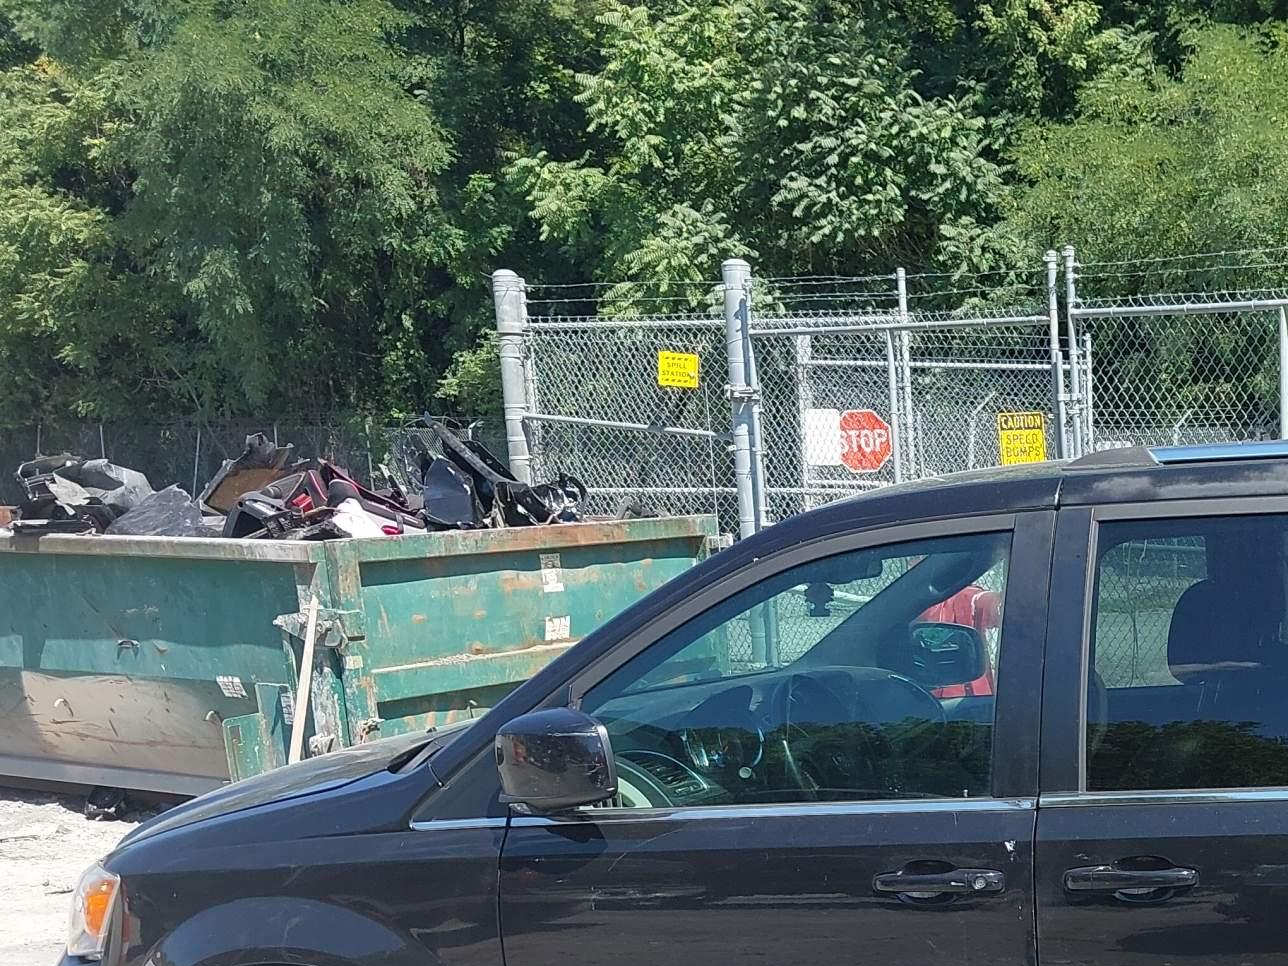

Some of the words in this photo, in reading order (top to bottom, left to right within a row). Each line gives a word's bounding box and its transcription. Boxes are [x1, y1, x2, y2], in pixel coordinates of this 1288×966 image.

[667, 362, 687, 370] SPILL
[1001, 414, 1041, 429] CAUTION
[840, 428, 888, 453] STOP
[1006, 433, 1038, 446] SPEED
[1006, 446, 1041, 458] BUMPS
